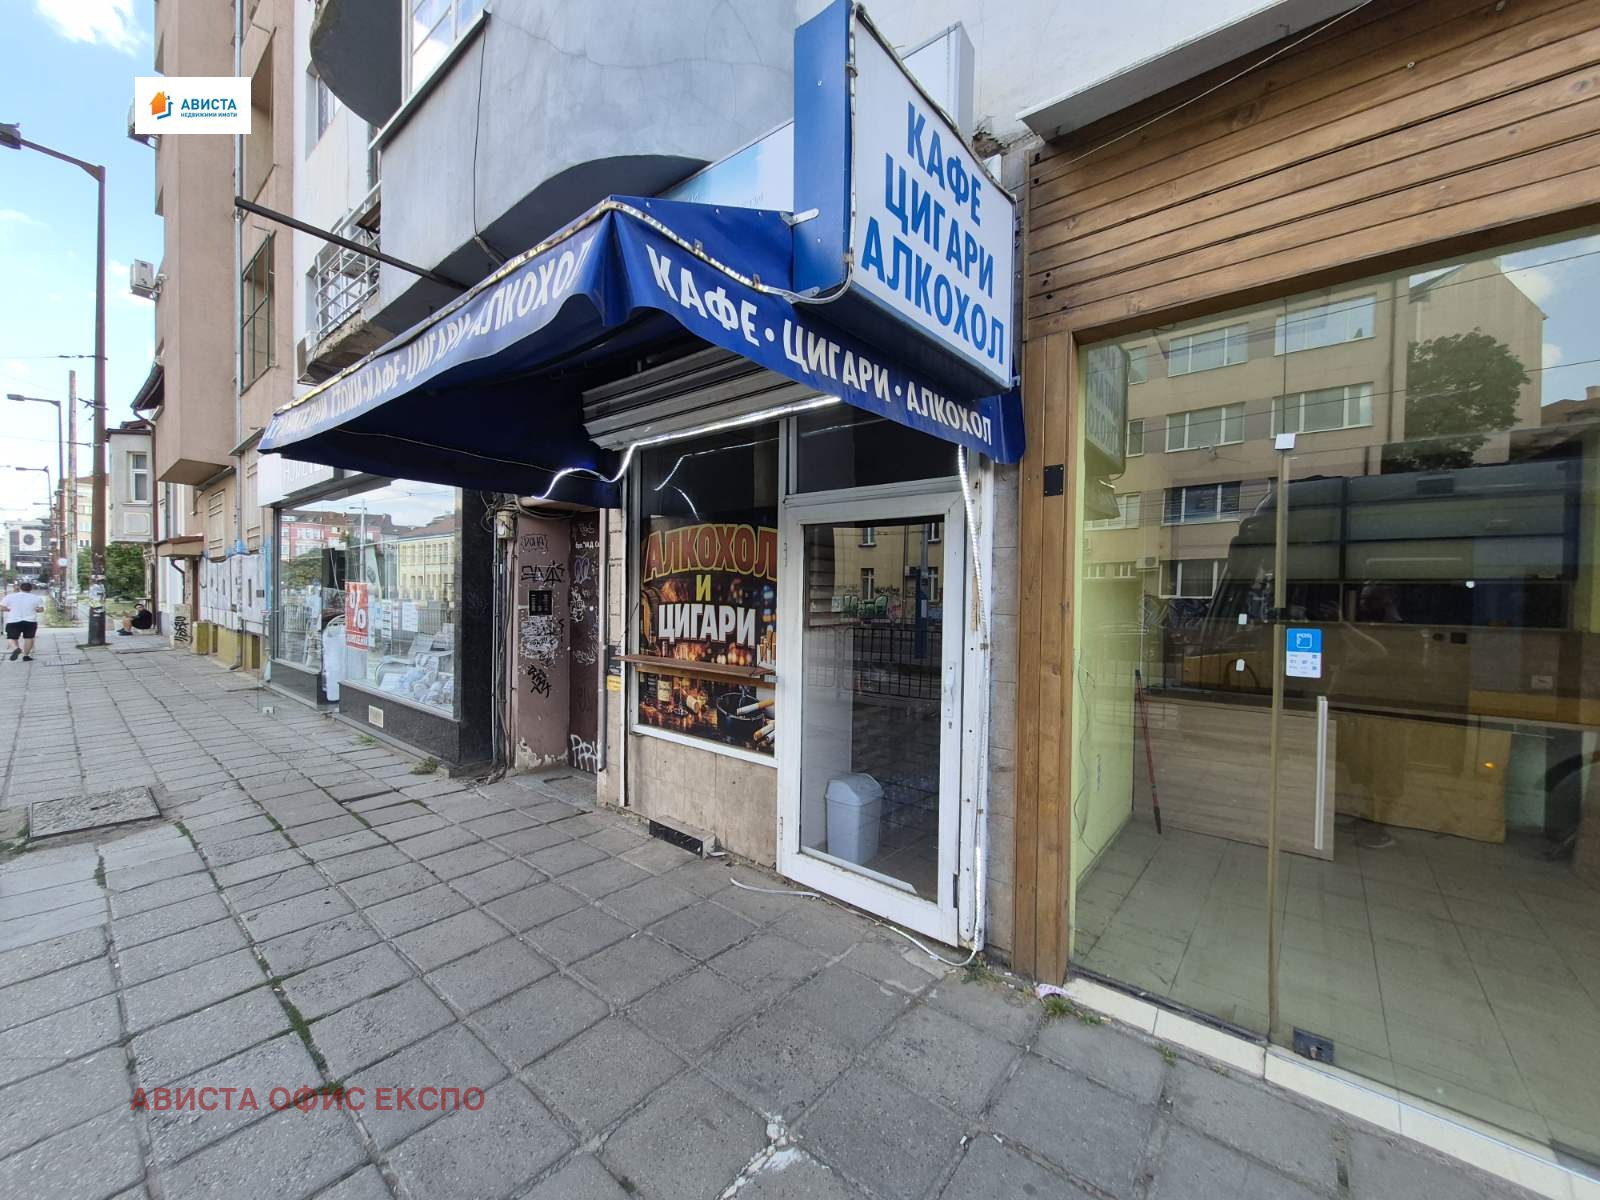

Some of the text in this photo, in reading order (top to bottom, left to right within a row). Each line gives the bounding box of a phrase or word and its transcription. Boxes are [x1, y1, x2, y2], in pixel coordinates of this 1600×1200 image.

[886, 152, 993, 299] ЦИГАРИ
[908, 101, 981, 227] КАФЕ
[646, 244, 760, 347] КАФЕ
[783, 319, 891, 403] ЦИГАРИ
[907, 381, 992, 446] АЛКОХОЛ
[861, 216, 1004, 364] АЛКОХОЛ
[644, 524, 777, 582] АЛКОХОЛ
[696, 574, 711, 601] И
[658, 603, 755, 647] ЦИГАРИ
